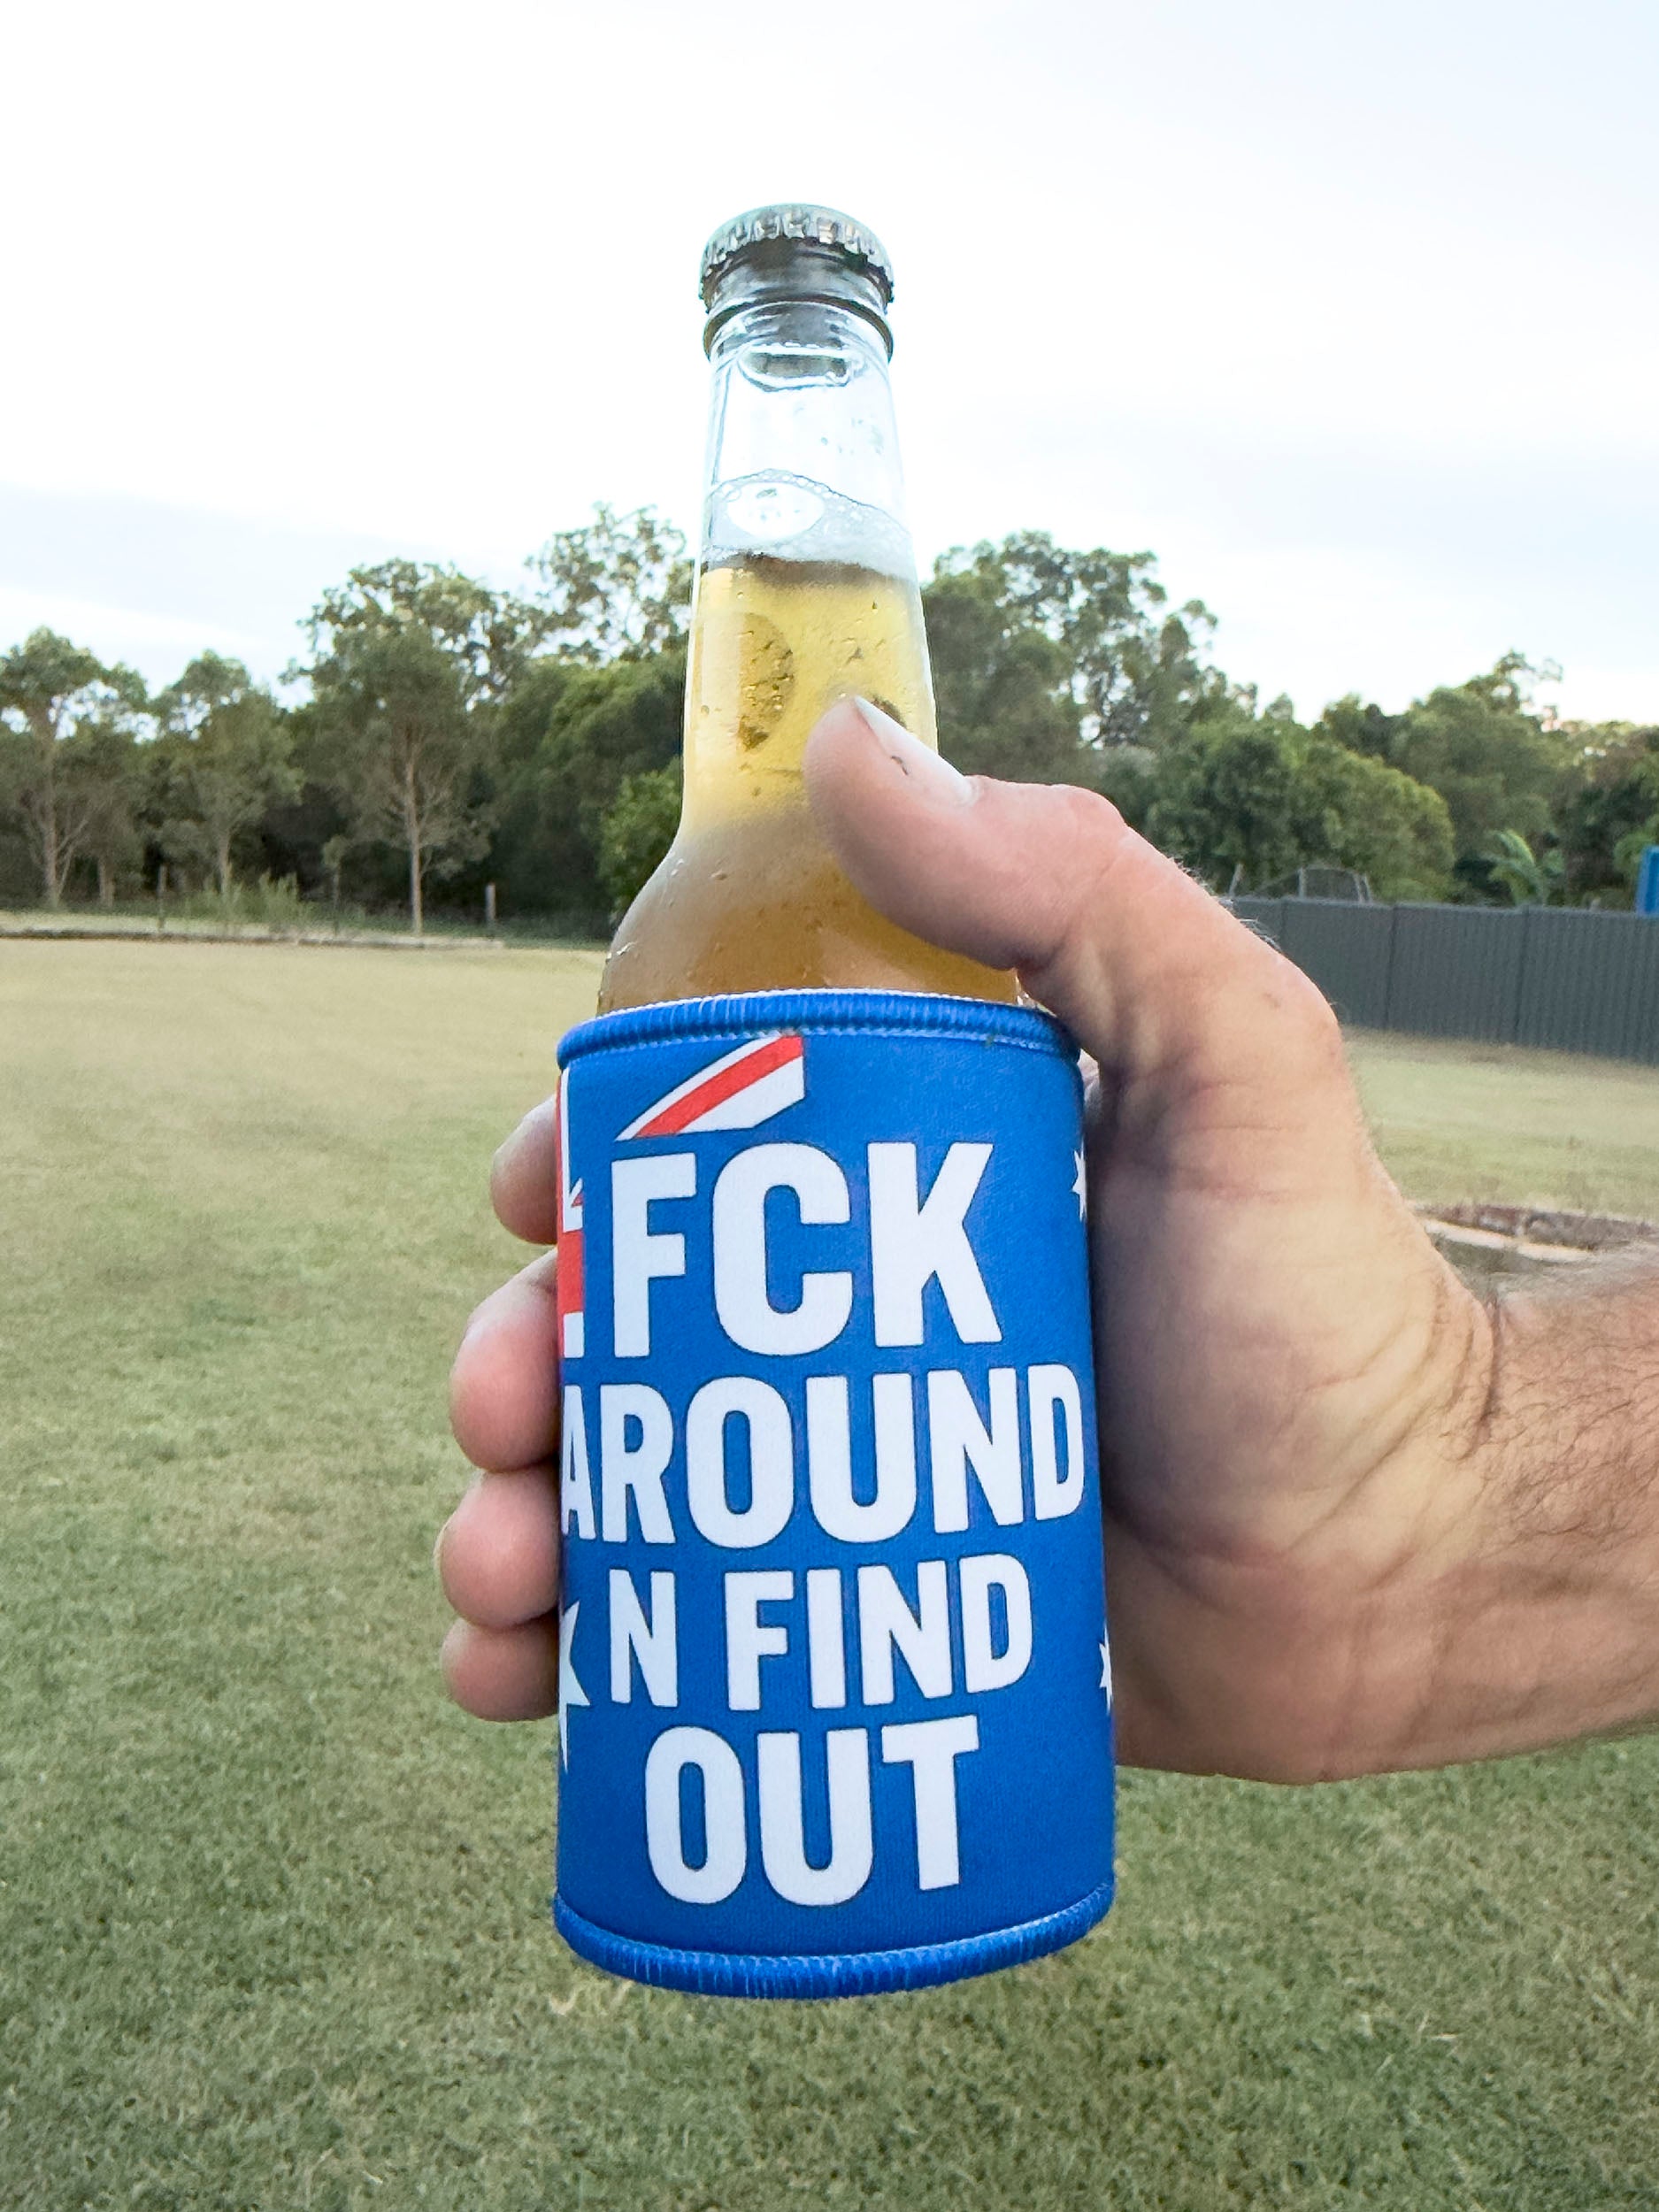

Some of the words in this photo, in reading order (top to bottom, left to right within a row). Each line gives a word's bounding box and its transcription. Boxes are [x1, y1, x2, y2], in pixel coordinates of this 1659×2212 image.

[611, 1141, 1002, 1358] FCK
[561, 1363, 1086, 1548] AROUND
[609, 1568, 679, 1708] N
[724, 1553, 1033, 1711] FIND
[645, 1714, 980, 1907] OUT
